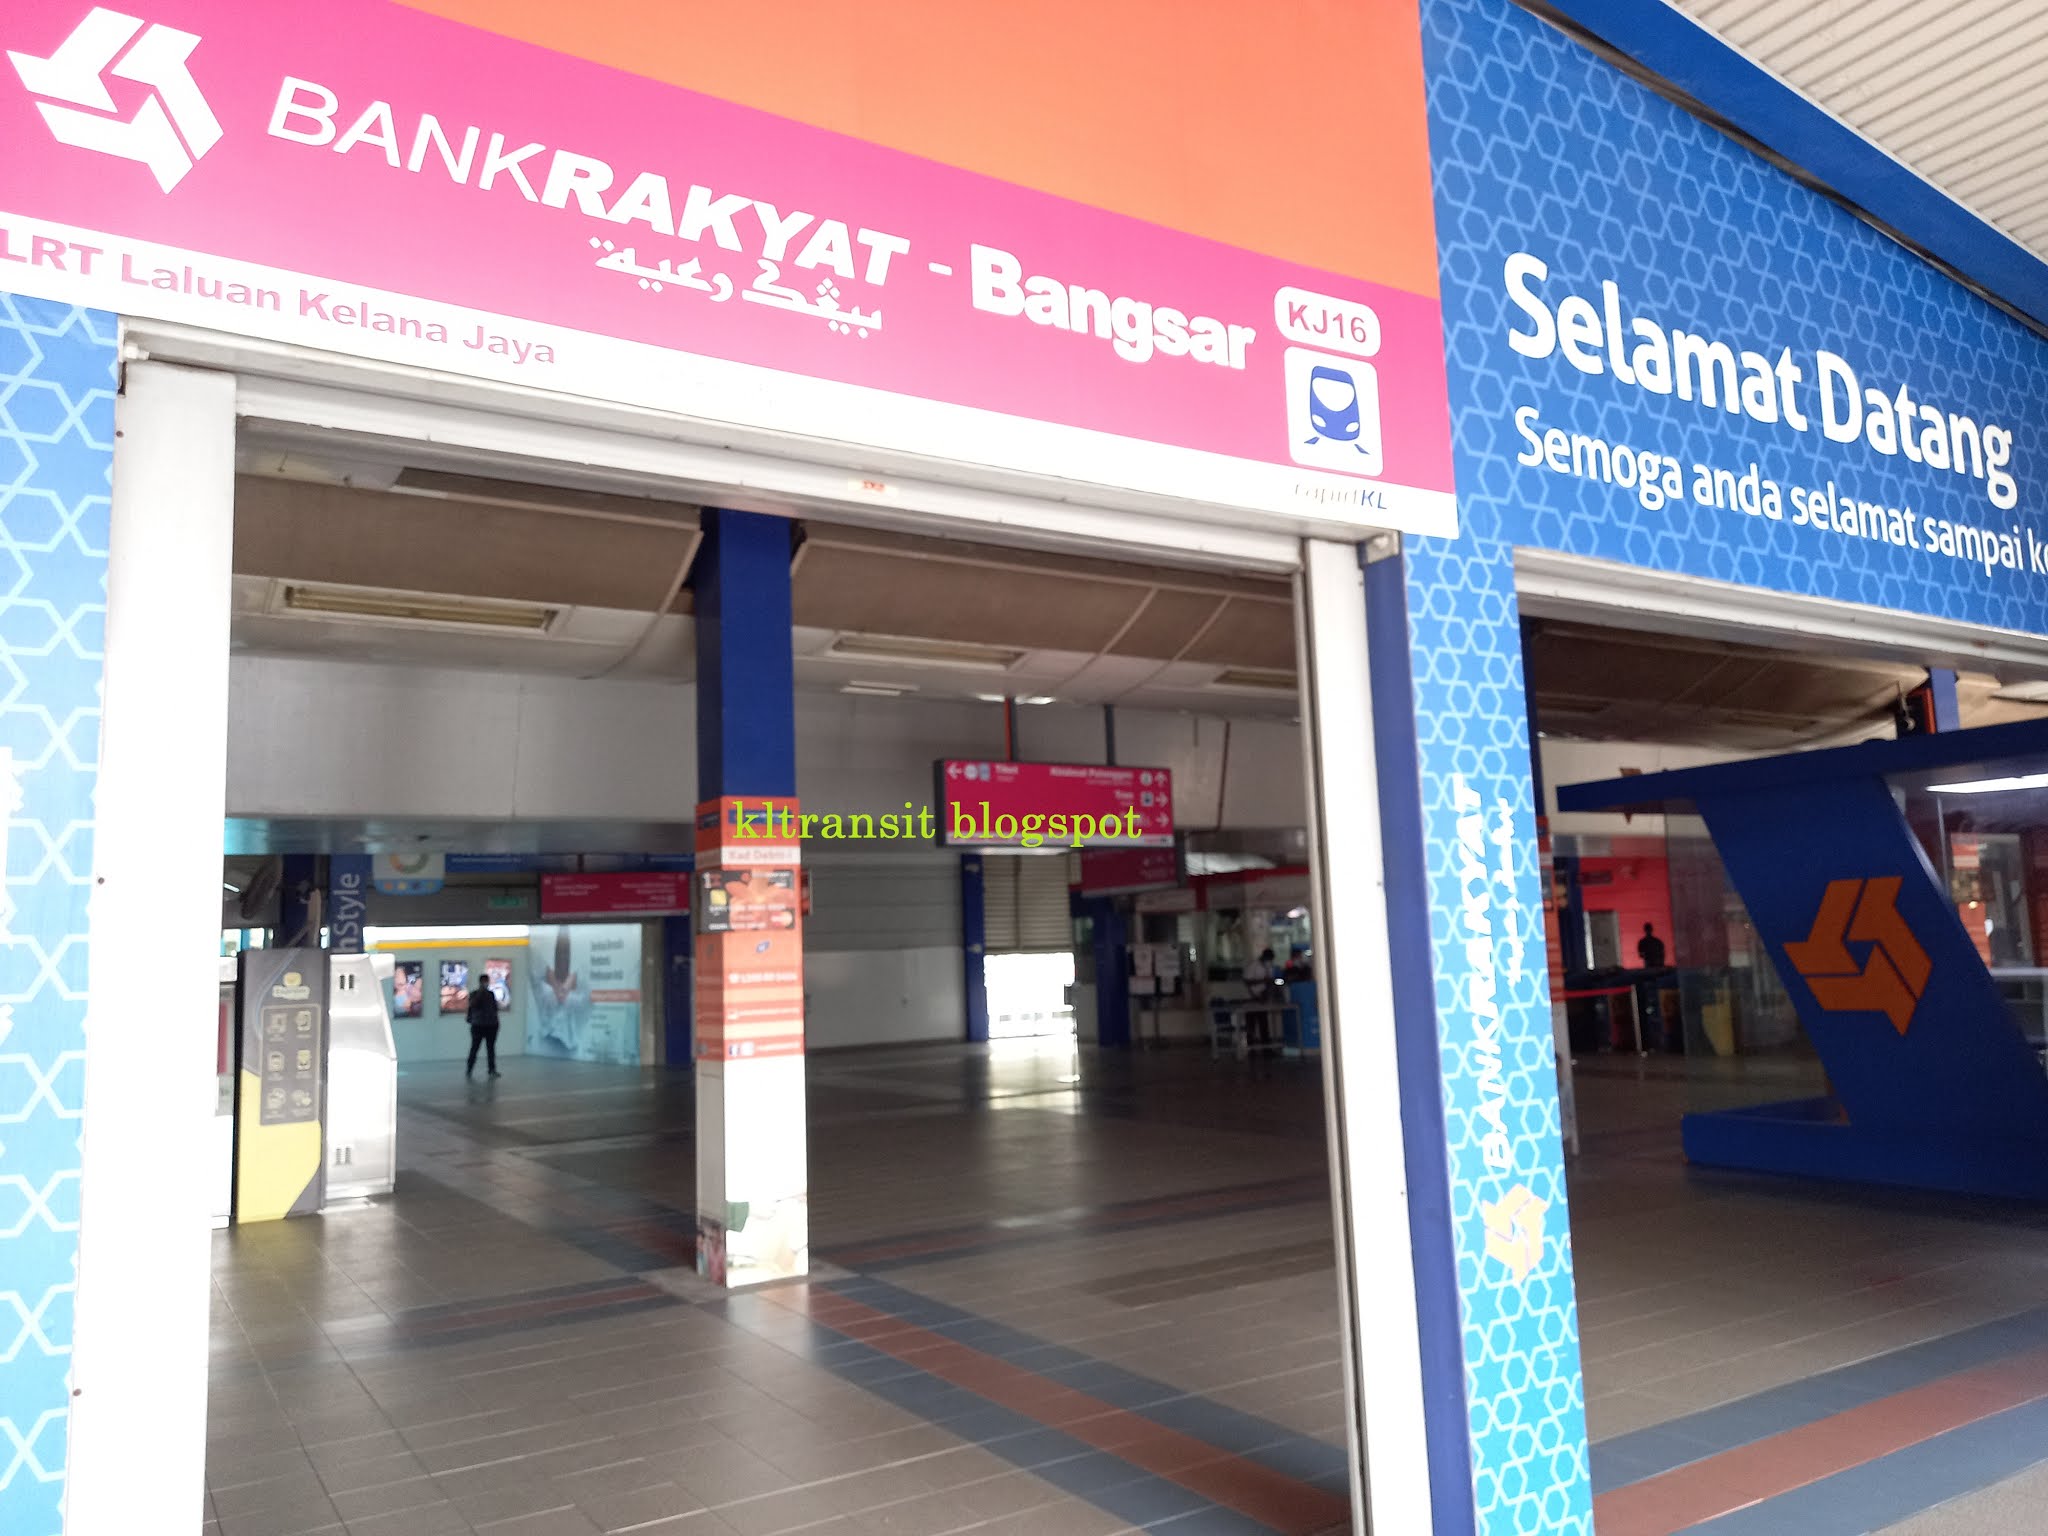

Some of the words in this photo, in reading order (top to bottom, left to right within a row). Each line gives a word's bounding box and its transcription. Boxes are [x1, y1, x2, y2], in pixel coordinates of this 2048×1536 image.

[0, 228, 103, 275] LRT
[120, 253, 281, 311] Laluan
[300, 292, 448, 344] Kelana
[462, 325, 556, 367] Jaya
[267, 76, 911, 287] BANKRAKYAT
[970, 243, 1256, 370] Bangsar
[1287, 301, 1368, 344] KJ16
[1503, 251, 1808, 433] Selamat
[1816, 350, 2018, 510] Datang
[1513, 405, 1683, 511] Semoga
[1692, 462, 1782, 521] anda
[1791, 481, 1919, 550] selamat
[1922, 516, 2023, 578] sampai
